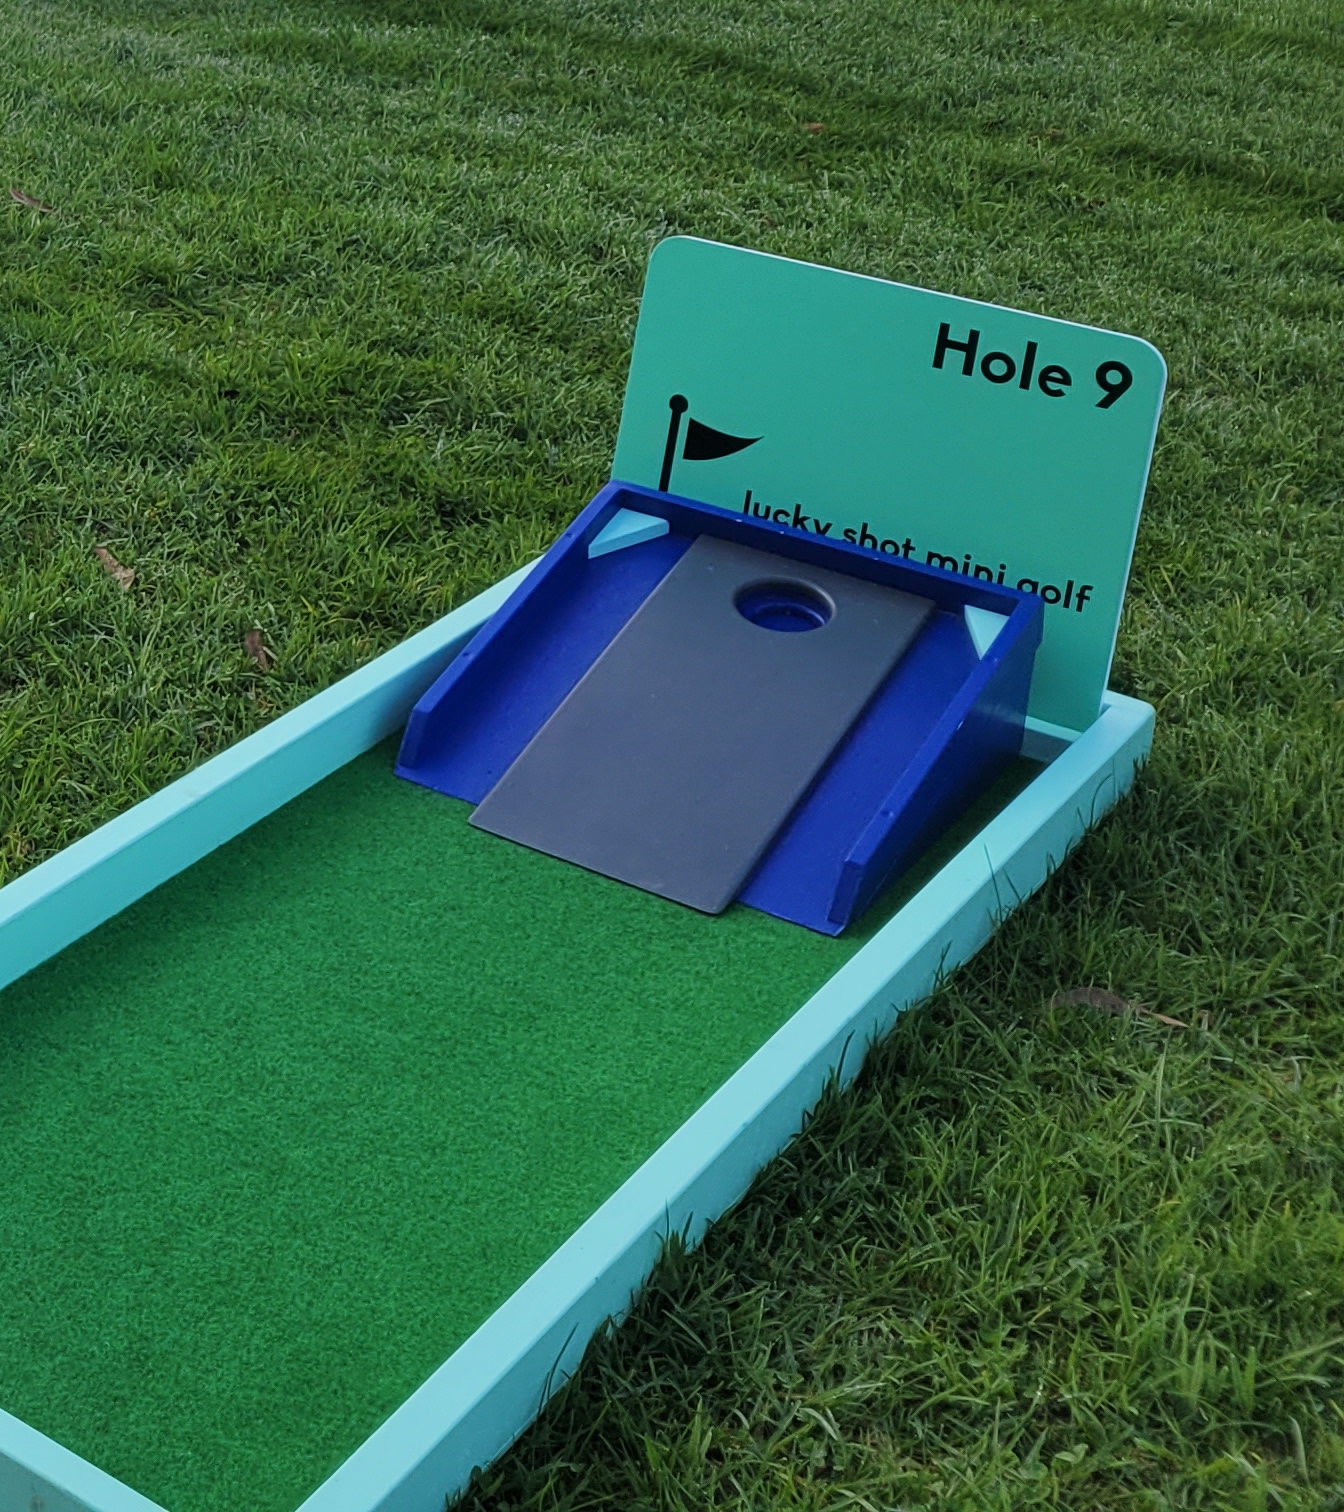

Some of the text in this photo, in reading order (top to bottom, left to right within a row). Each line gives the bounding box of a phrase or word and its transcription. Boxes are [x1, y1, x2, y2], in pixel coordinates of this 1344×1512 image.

[931, 322, 1134, 409] Hole 9
[842, 522, 917, 559] shot
[925, 550, 1007, 585] mini
